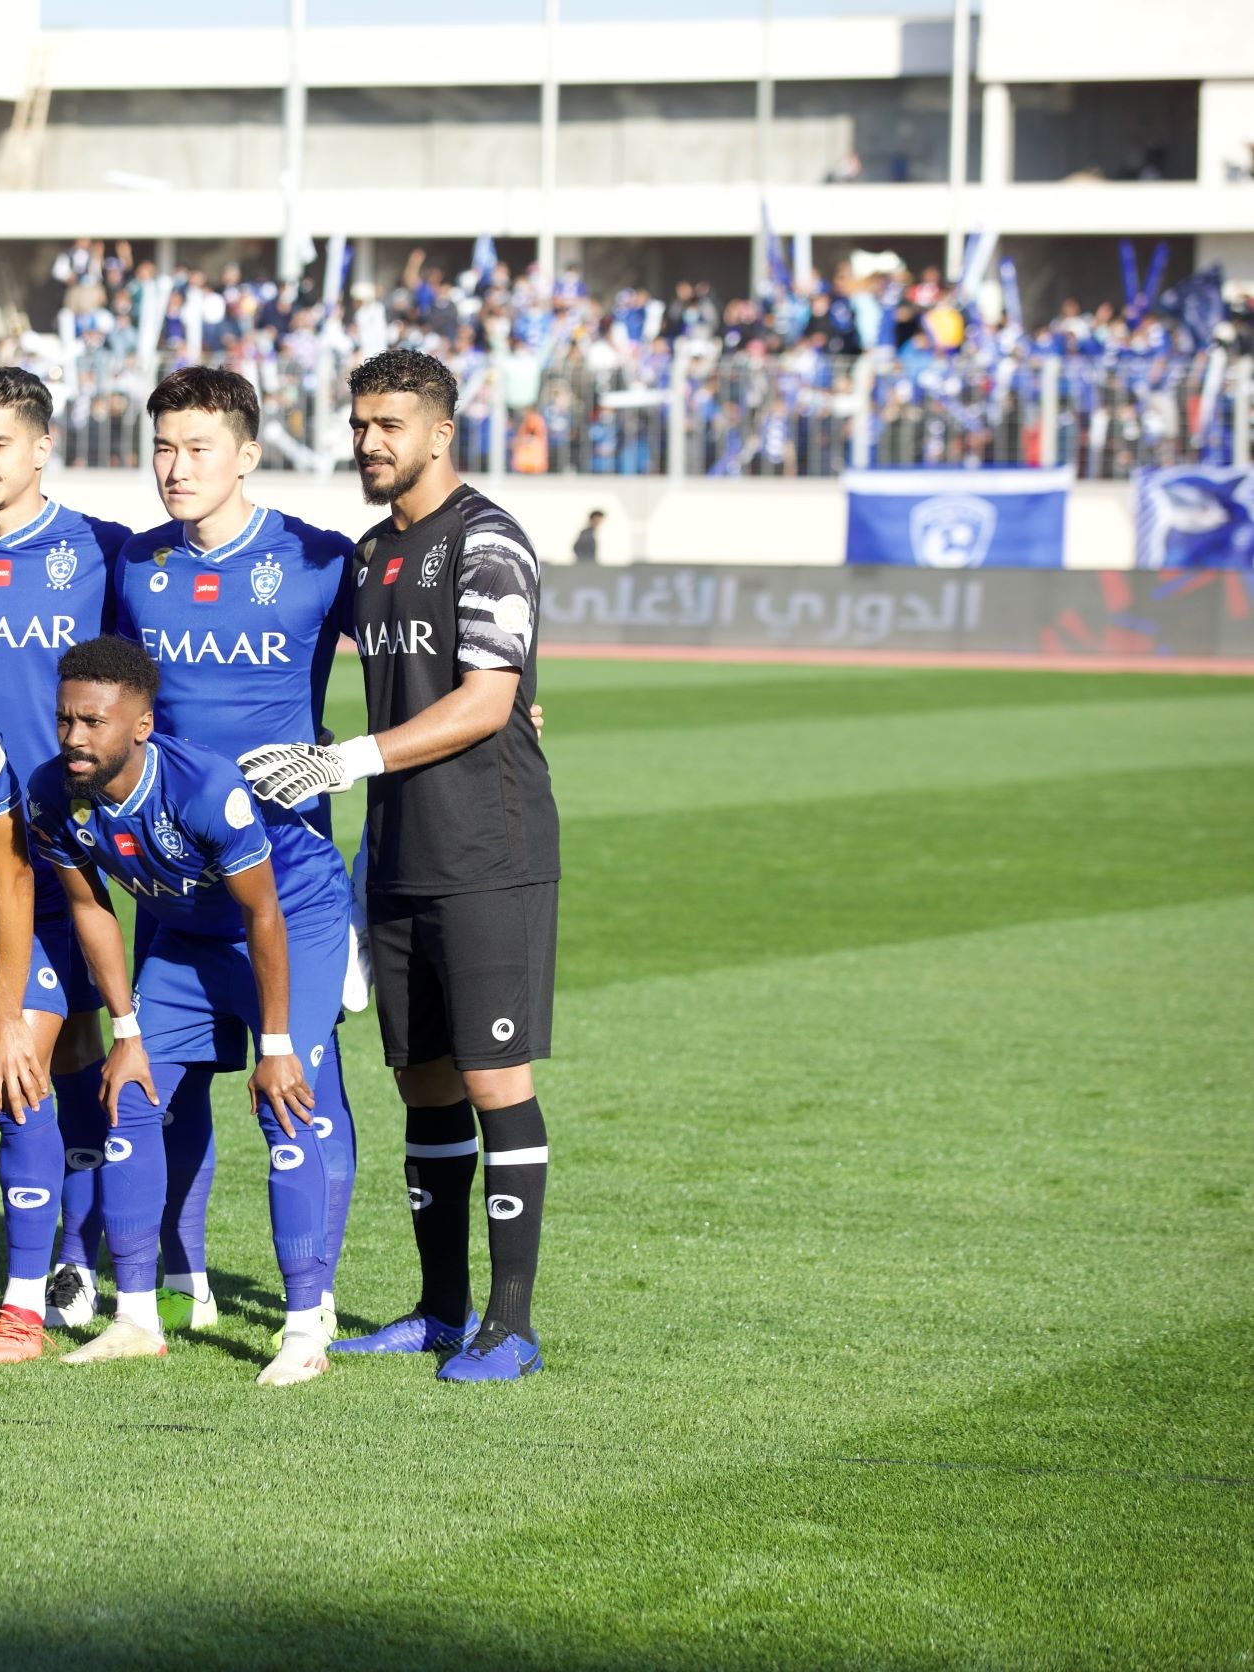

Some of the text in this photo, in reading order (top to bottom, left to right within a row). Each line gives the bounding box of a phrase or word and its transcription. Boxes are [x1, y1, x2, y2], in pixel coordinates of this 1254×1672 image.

[753, 580, 984, 642] الدوري
[141, 628, 291, 665] EMAAR
[355, 620, 437, 657] MAAR
[111, 863, 223, 897] MAAR
